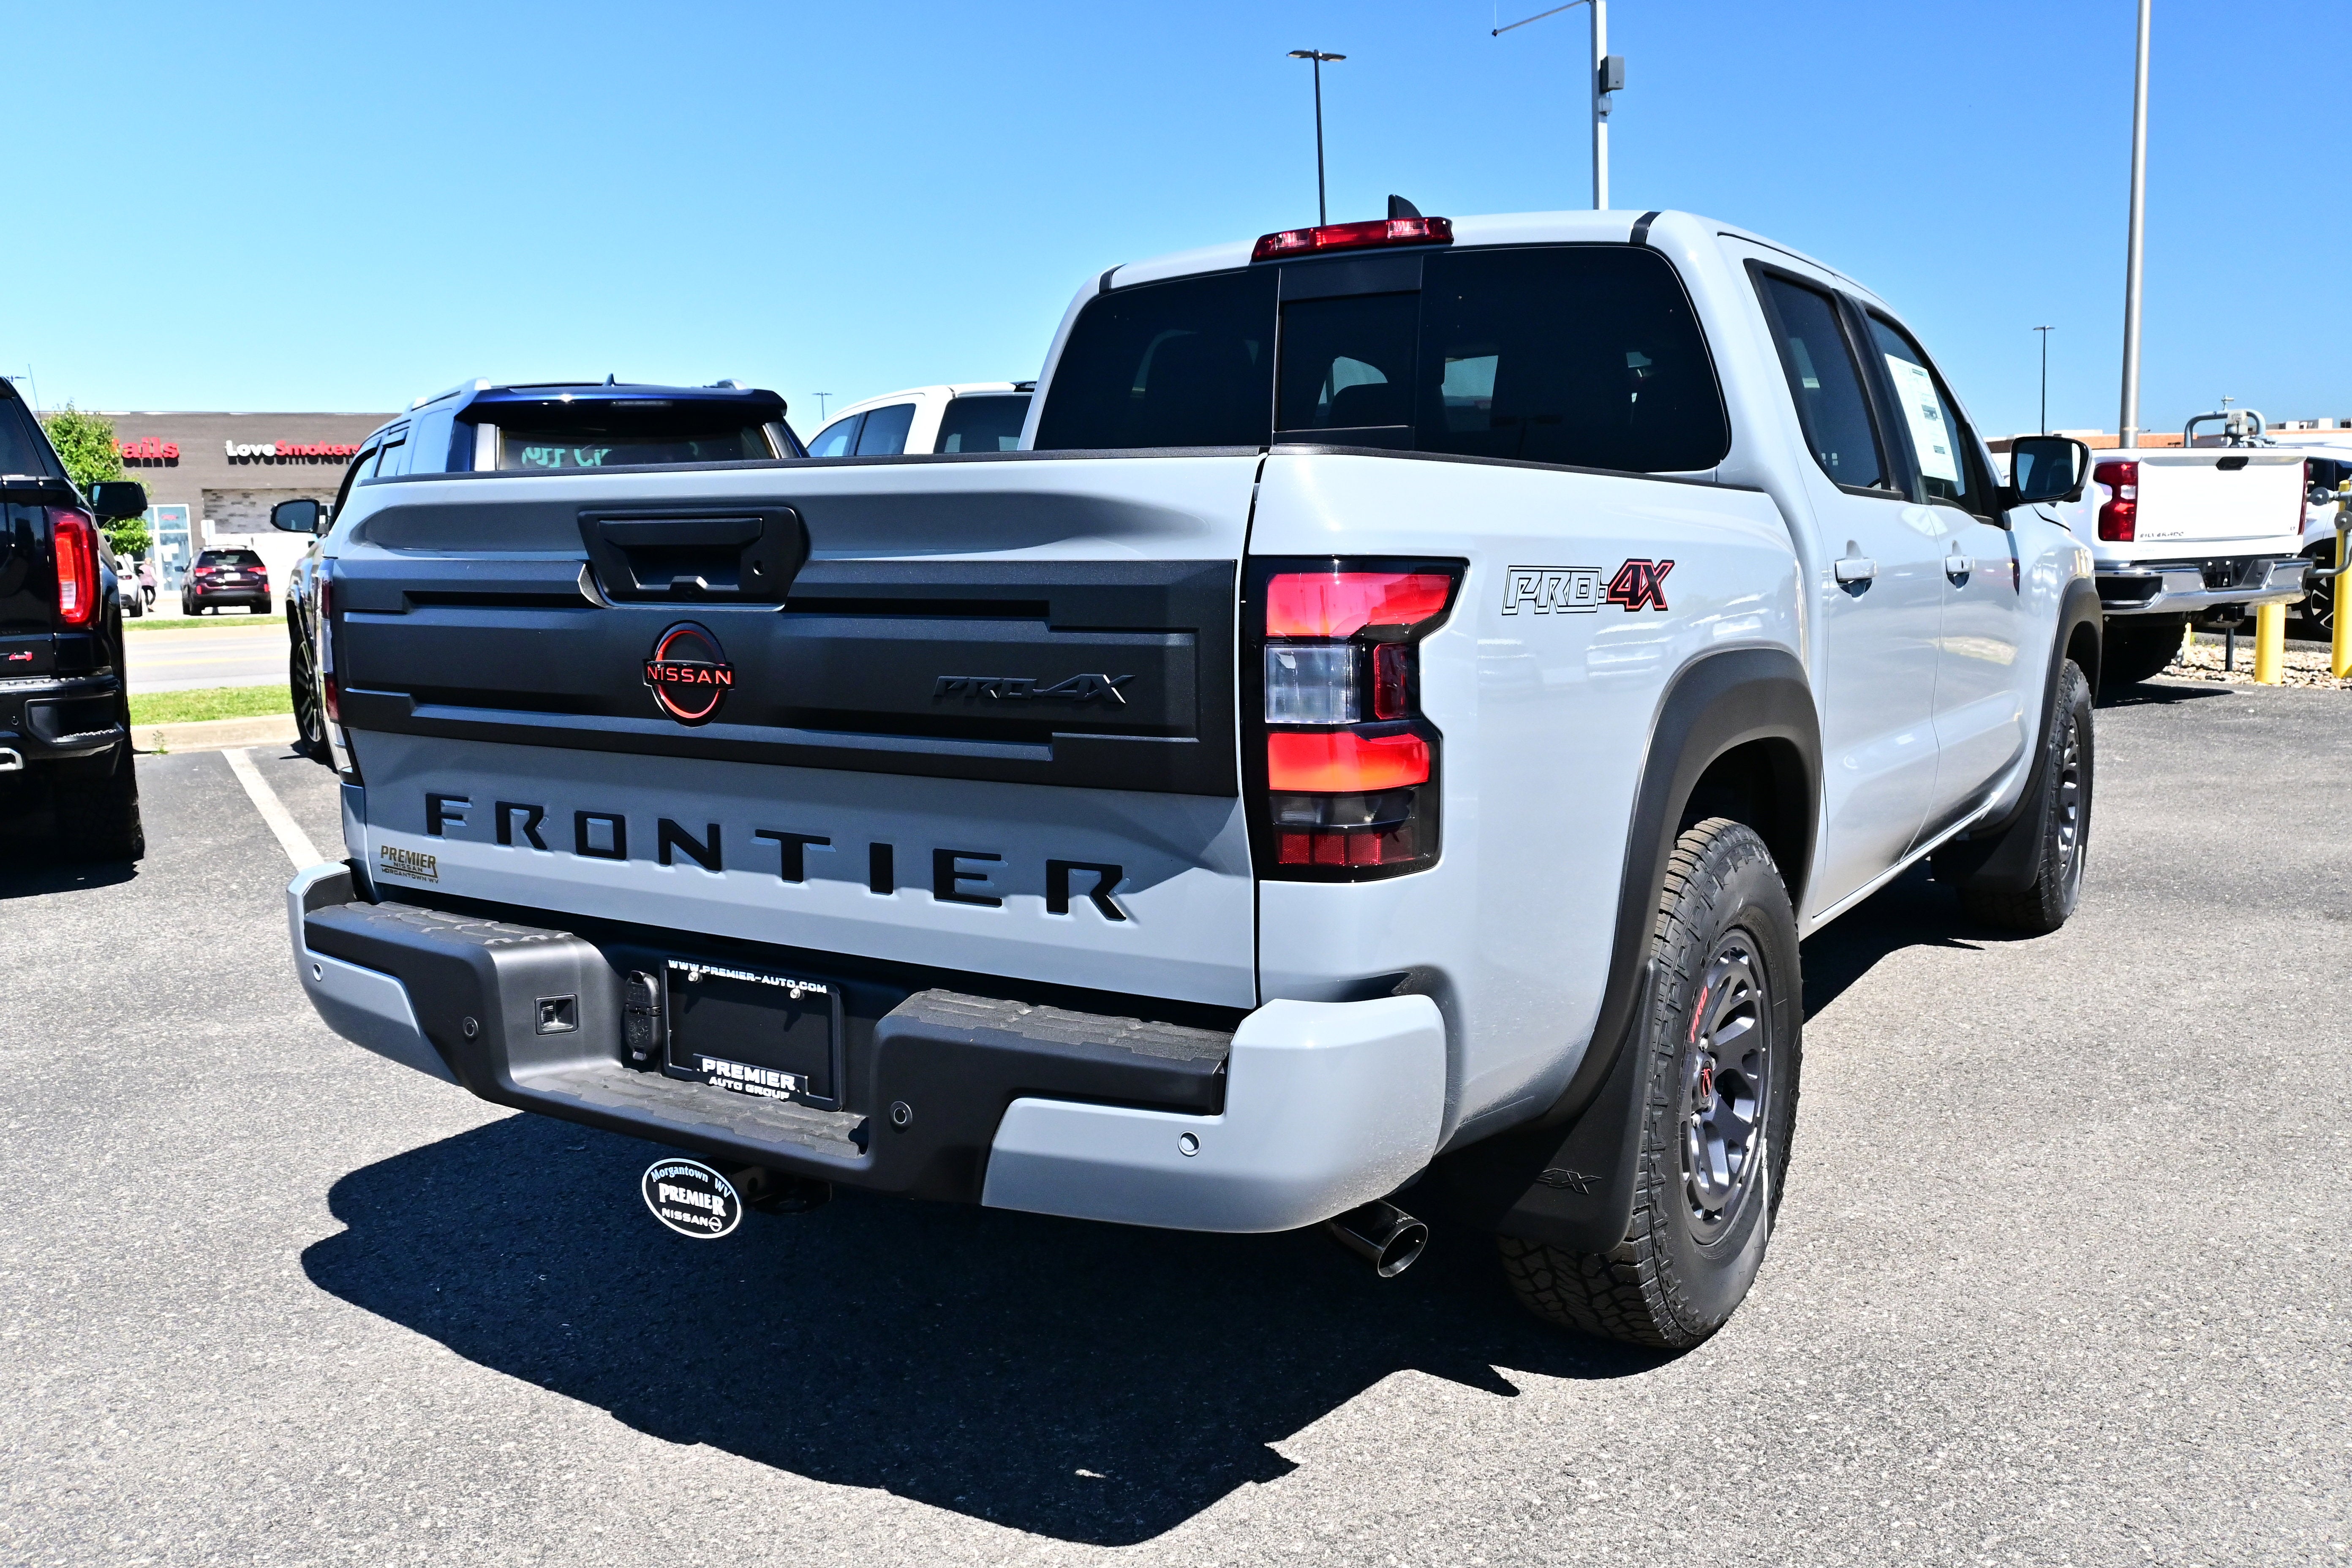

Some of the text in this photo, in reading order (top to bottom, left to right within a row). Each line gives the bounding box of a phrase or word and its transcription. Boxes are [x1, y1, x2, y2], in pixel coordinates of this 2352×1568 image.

[647, 665, 732, 685] NISSAN
[380, 845, 438, 870] PREMIER
[393, 861, 423, 873] NISSAN
[425, 792, 1127, 922] FRONTIER
[381, 868, 427, 882] MORGANTOWN
[667, 959, 827, 994] WWW.PREMIER-AUTO.COM
[702, 1058, 796, 1091] PREMIER
[708, 1076, 790, 1100] AUTO GROUP
[651, 1166, 732, 1198] Morgantown WV
[658, 1182, 727, 1217] PREMIER
[661, 1207, 708, 1227] NISSAN
